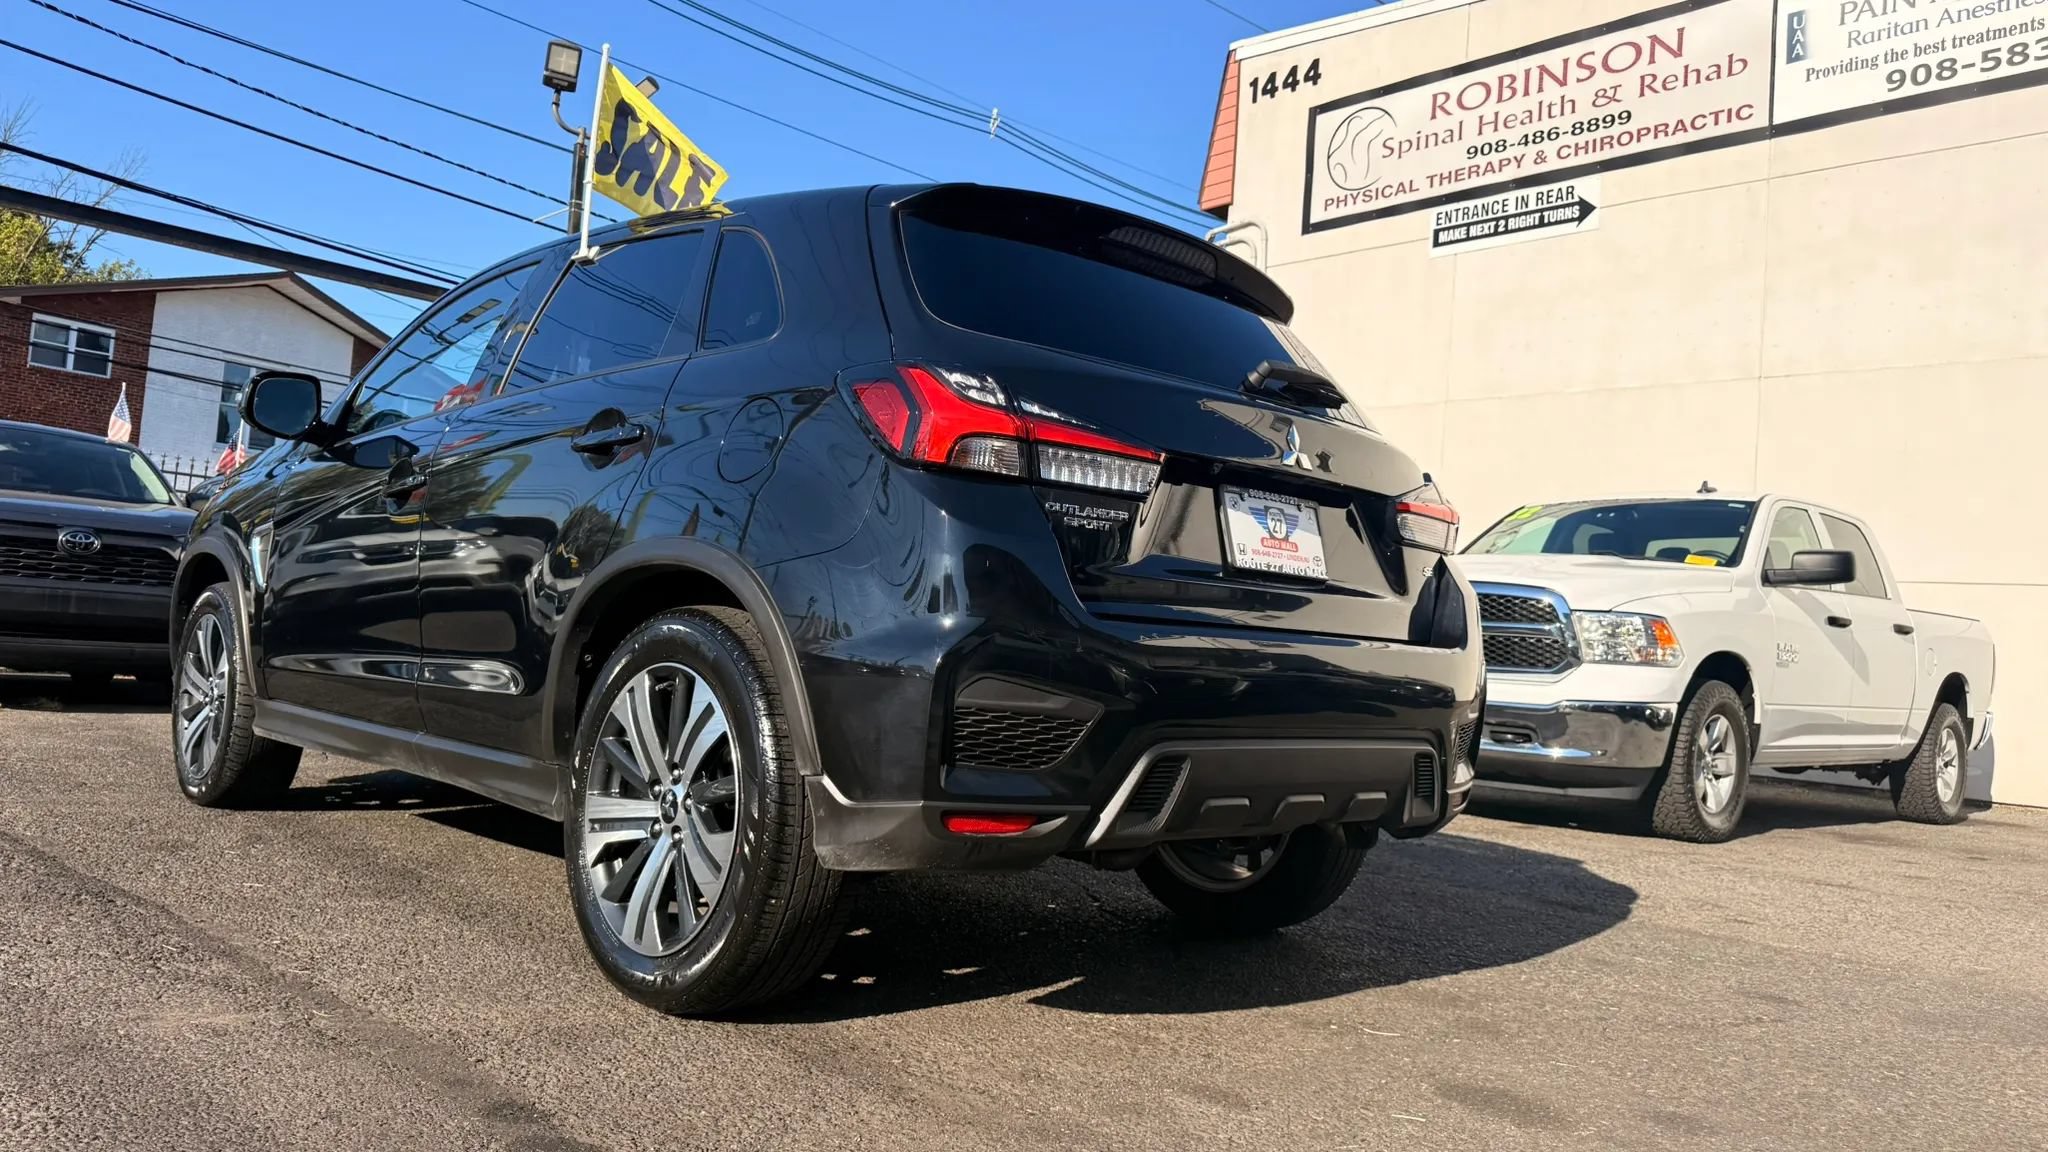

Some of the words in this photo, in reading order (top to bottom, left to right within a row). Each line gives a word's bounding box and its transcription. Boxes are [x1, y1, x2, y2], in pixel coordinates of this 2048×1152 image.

[1791, 14, 1806, 58] UAA
[1805, 54, 1880, 82] Providing
[1884, 48, 1909, 64] the
[1913, 37, 1947, 58] best
[1951, 16, 2045, 49] treatments
[1847, 18, 1929, 48] Raritan
[1249, 58, 1322, 104] 1444
[1430, 27, 1686, 120] ROBINSON
[1885, 36, 2048, 93] 908-583
[1382, 120, 1463, 159] Spinal
[1477, 95, 1577, 136] Health
[1592, 84, 1623, 108] &
[1638, 53, 1749, 98] Rehab
[1466, 110, 1632, 160] 908-486-8899
[1324, 180, 1420, 212] PHYSICAL
[1426, 154, 1526, 189] THERAPY
[1533, 150, 1548, 165] &
[1556, 104, 1755, 160] CHIROPRACTIC
[1436, 199, 1510, 227] ENTRANCE
[1515, 194, 1530, 211] IN
[1535, 185, 1576, 207] REAR
[1438, 226, 1468, 244] MAKE
[1469, 220, 1497, 238] NEXT
[1498, 219, 1506, 232] 2
[1508, 213, 1542, 230] RIGHT
[1543, 205, 1581, 224] TURNS
[1045, 502, 1129, 521] OUTLANDER
[1064, 517, 1113, 531] SPORT
[1270, 517, 1284, 535] 27
[1263, 540, 1280, 549] AUTO
[1237, 558, 1268, 570] ROUTE
[1282, 562, 1305, 576] AUTO
